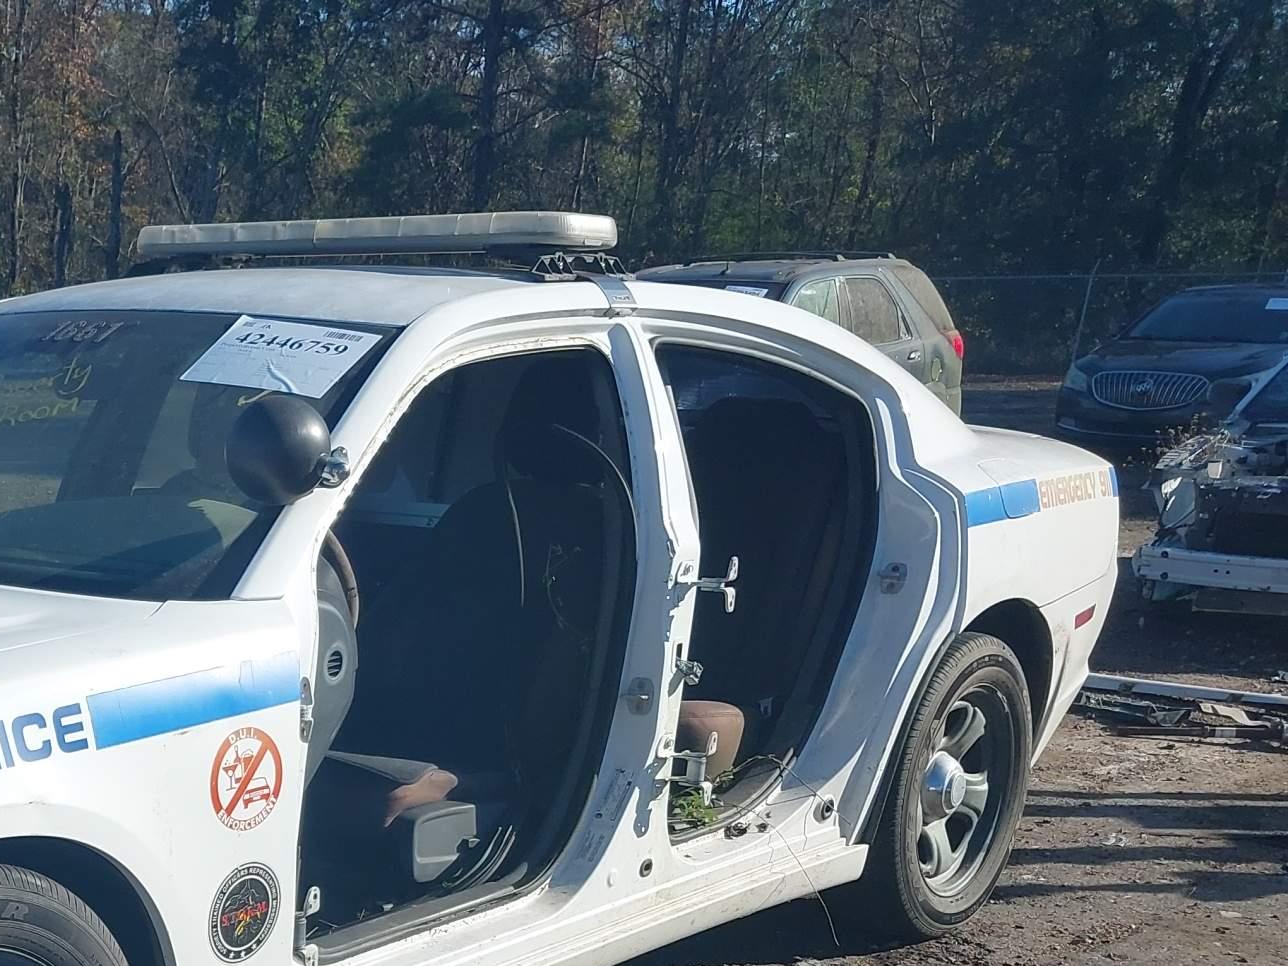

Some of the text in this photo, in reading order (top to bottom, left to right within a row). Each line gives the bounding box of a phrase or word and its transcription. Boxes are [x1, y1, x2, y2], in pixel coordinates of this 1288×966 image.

[235, 331, 350, 356] 42446759
[1039, 472, 1095, 508] EMERGENCY
[216, 794, 278, 831] ENFORCEMENT
